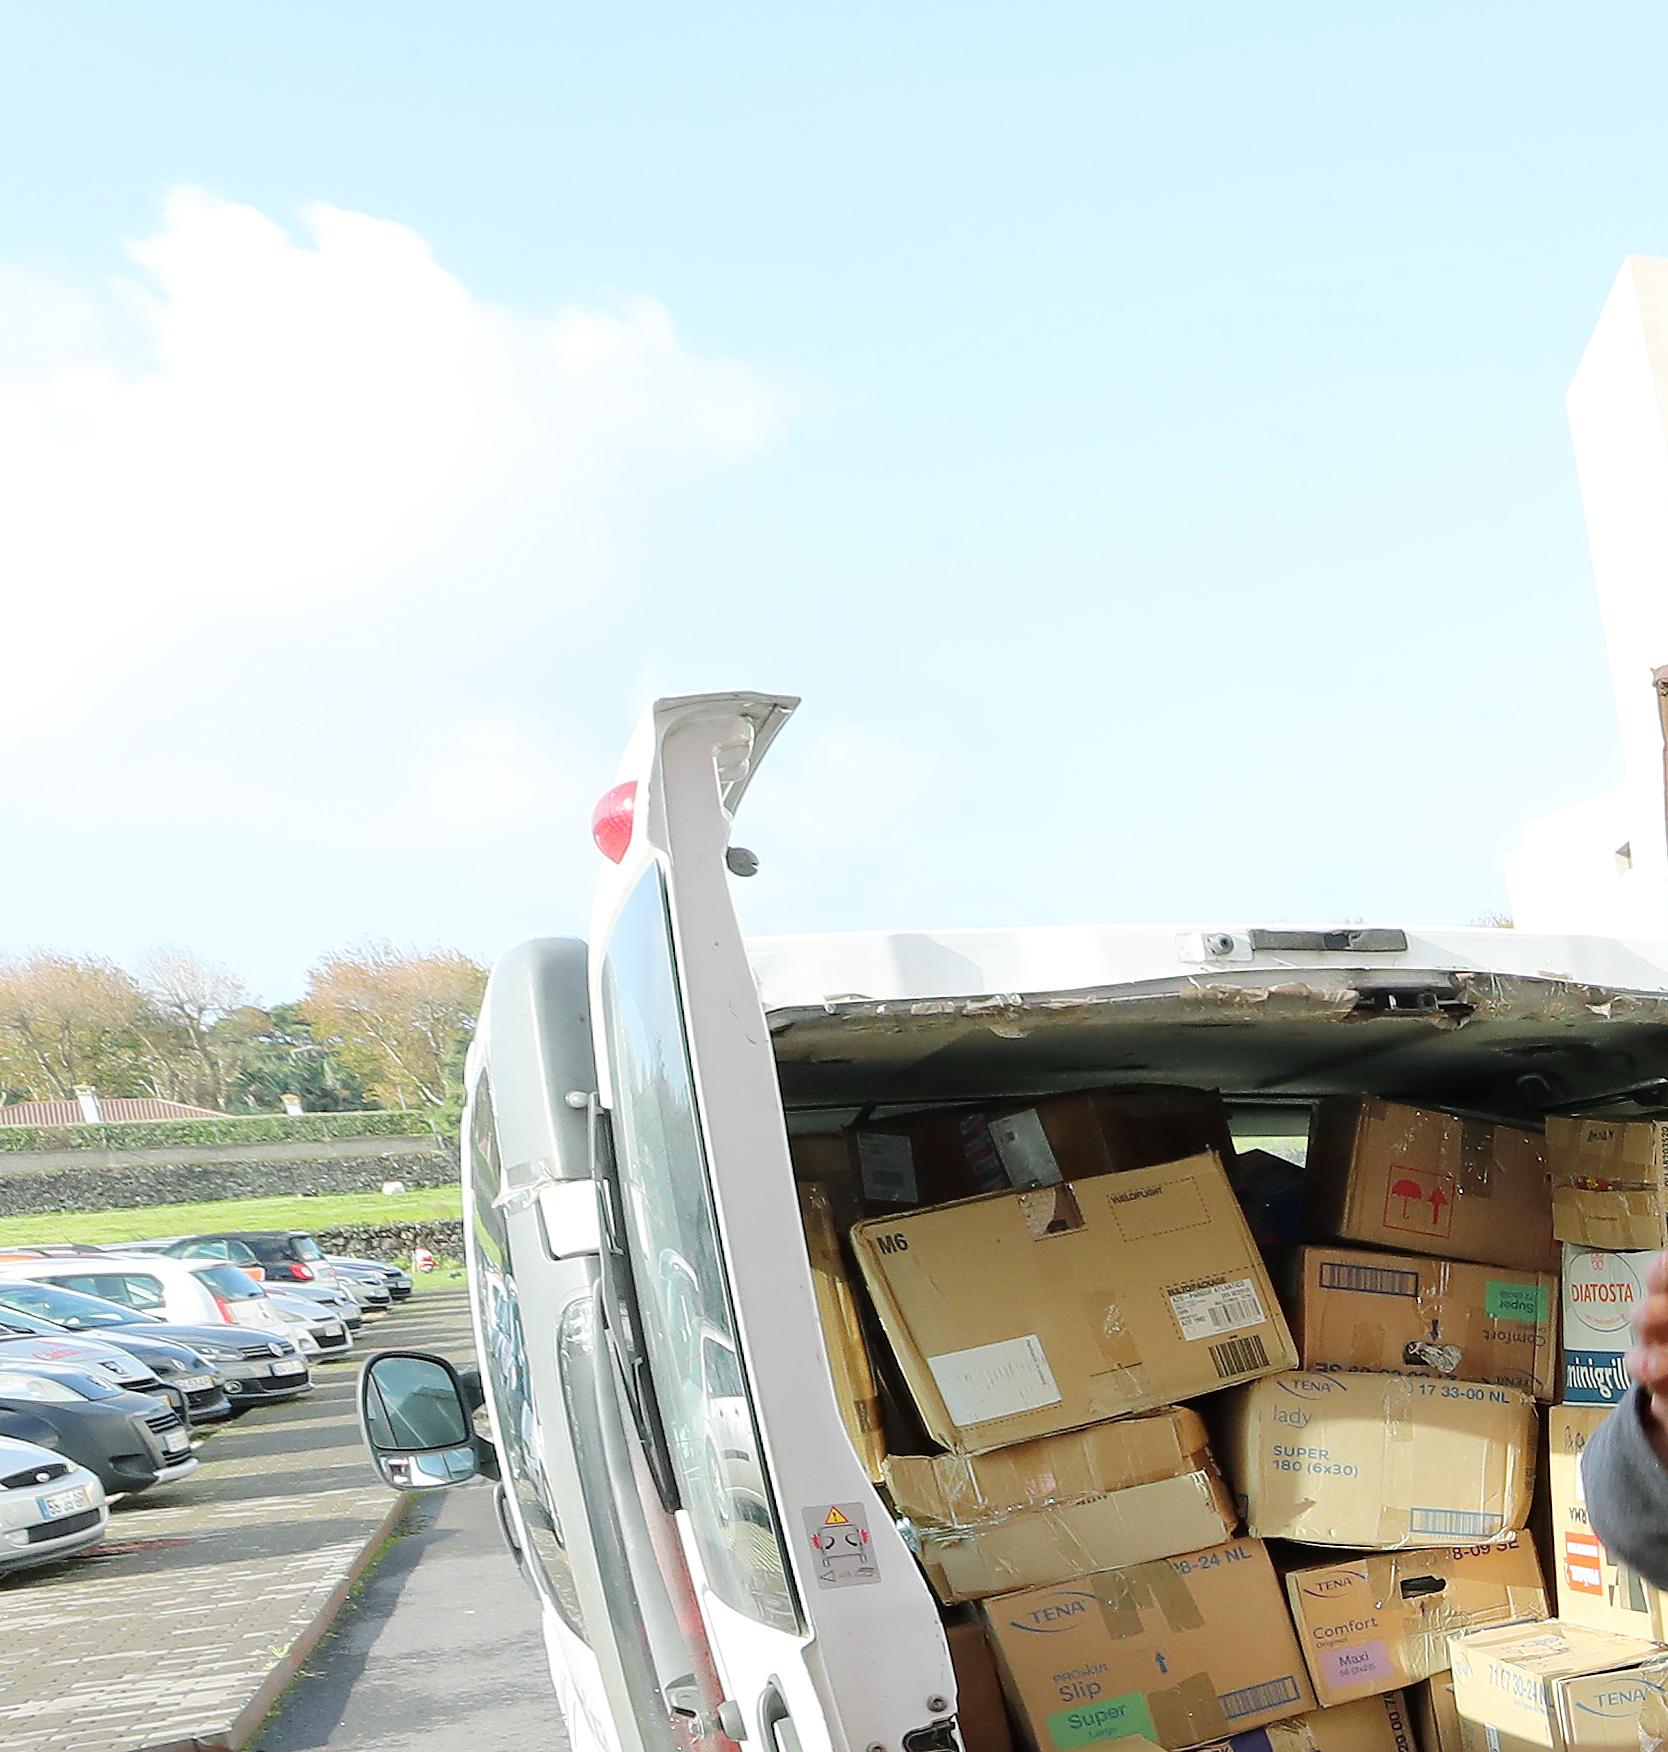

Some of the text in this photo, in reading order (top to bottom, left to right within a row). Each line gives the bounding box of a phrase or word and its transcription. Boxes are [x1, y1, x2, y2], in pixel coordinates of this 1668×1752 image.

[876, 1233, 909, 1255] M6
[1571, 1283, 1633, 1302] DIATOSTA
[1498, 1298, 1534, 1313] Super
[1481, 1329, 1545, 1346] Comfort
[1292, 1379, 1333, 1393] TENA
[1419, 1384, 1510, 1404] 17 33-00 NL
[1272, 1406, 1313, 1429] lady
[1272, 1445, 1329, 1460] SUPER
[1272, 1460, 1359, 1479] 180 (6x30)
[1224, 1547, 1253, 1564] NL
[1315, 1576, 1353, 1592] TENA
[1027, 1601, 1087, 1626] TENA
[1312, 1616, 1379, 1641] Comfort
[1338, 1651, 1370, 1668] Maxi
[1059, 1680, 1102, 1702] Slip
[1593, 1688, 1648, 1708] TENA
[1067, 1703, 1128, 1730] Super
